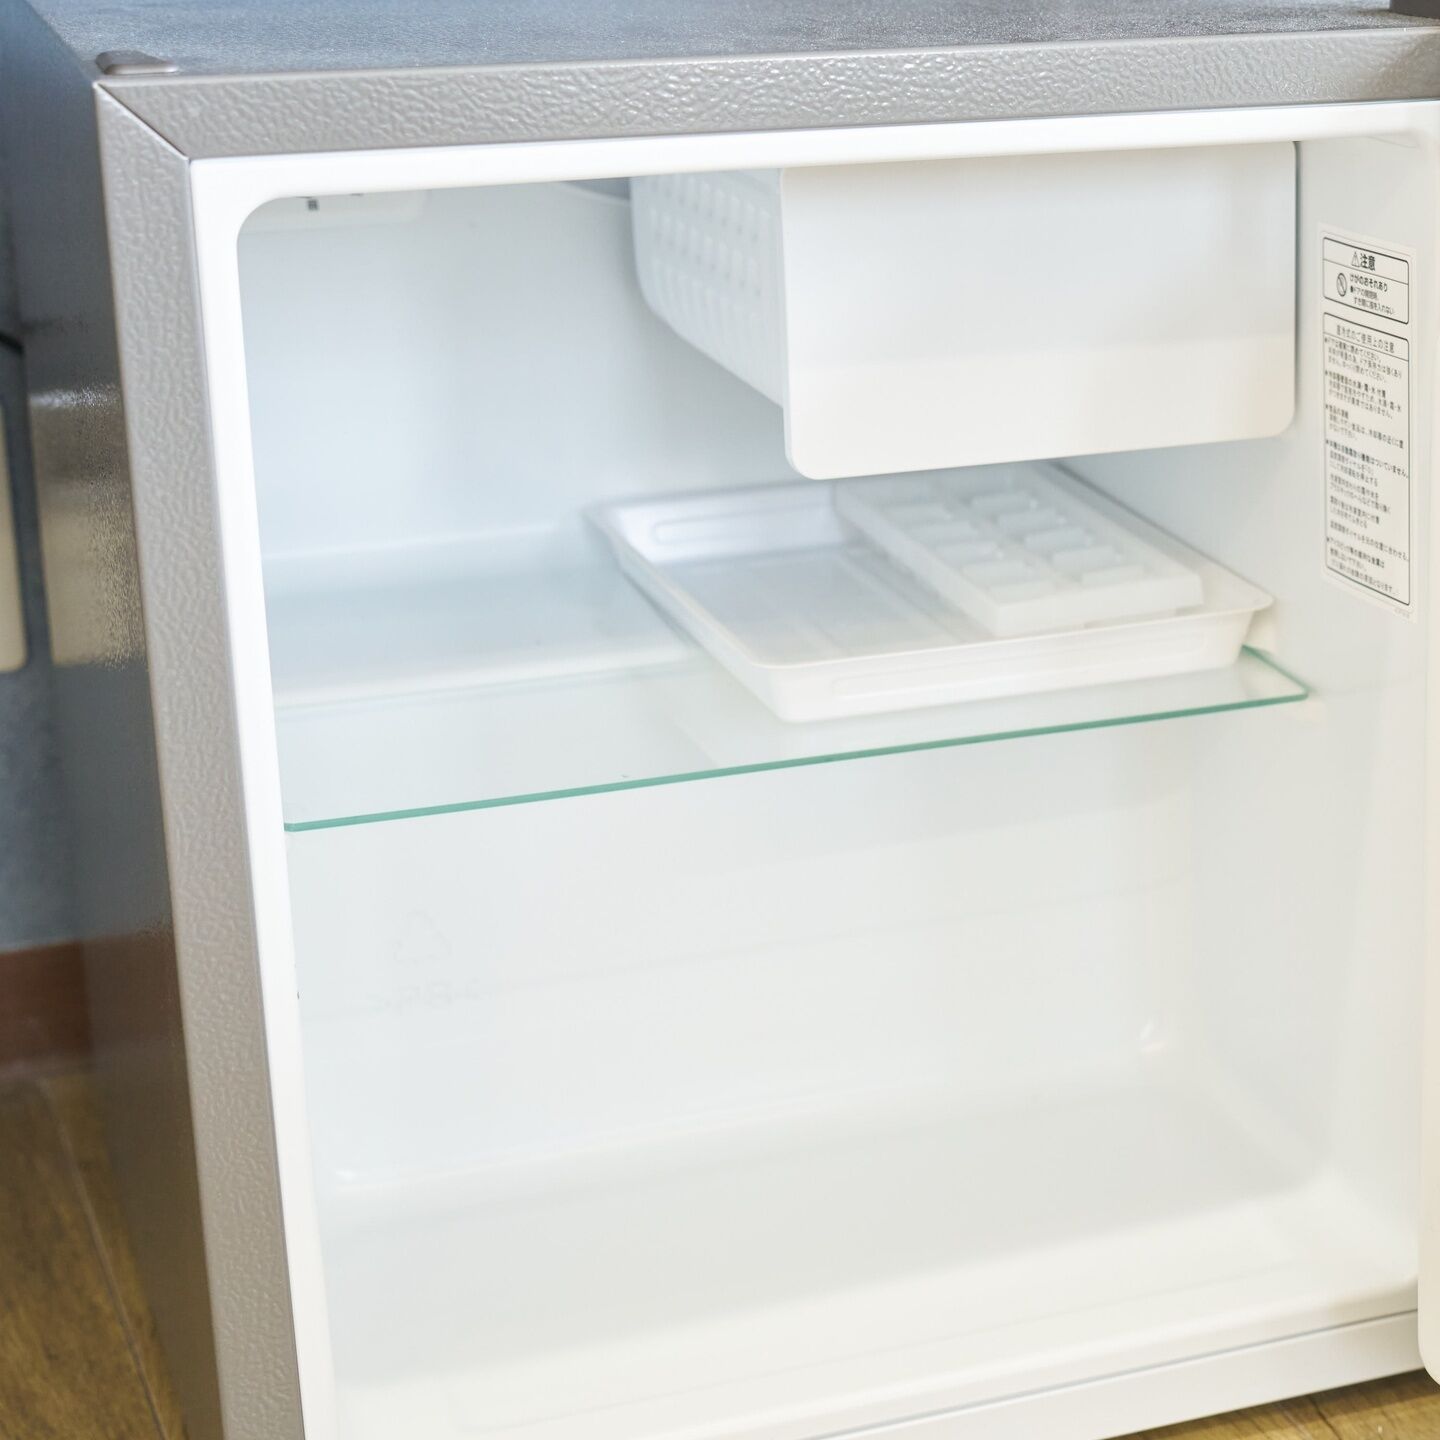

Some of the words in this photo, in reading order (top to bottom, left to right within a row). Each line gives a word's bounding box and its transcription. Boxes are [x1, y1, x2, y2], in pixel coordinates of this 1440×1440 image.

[1360, 253, 1375, 271] 注意
[1350, 274, 1388, 292] けがのおそれあり
